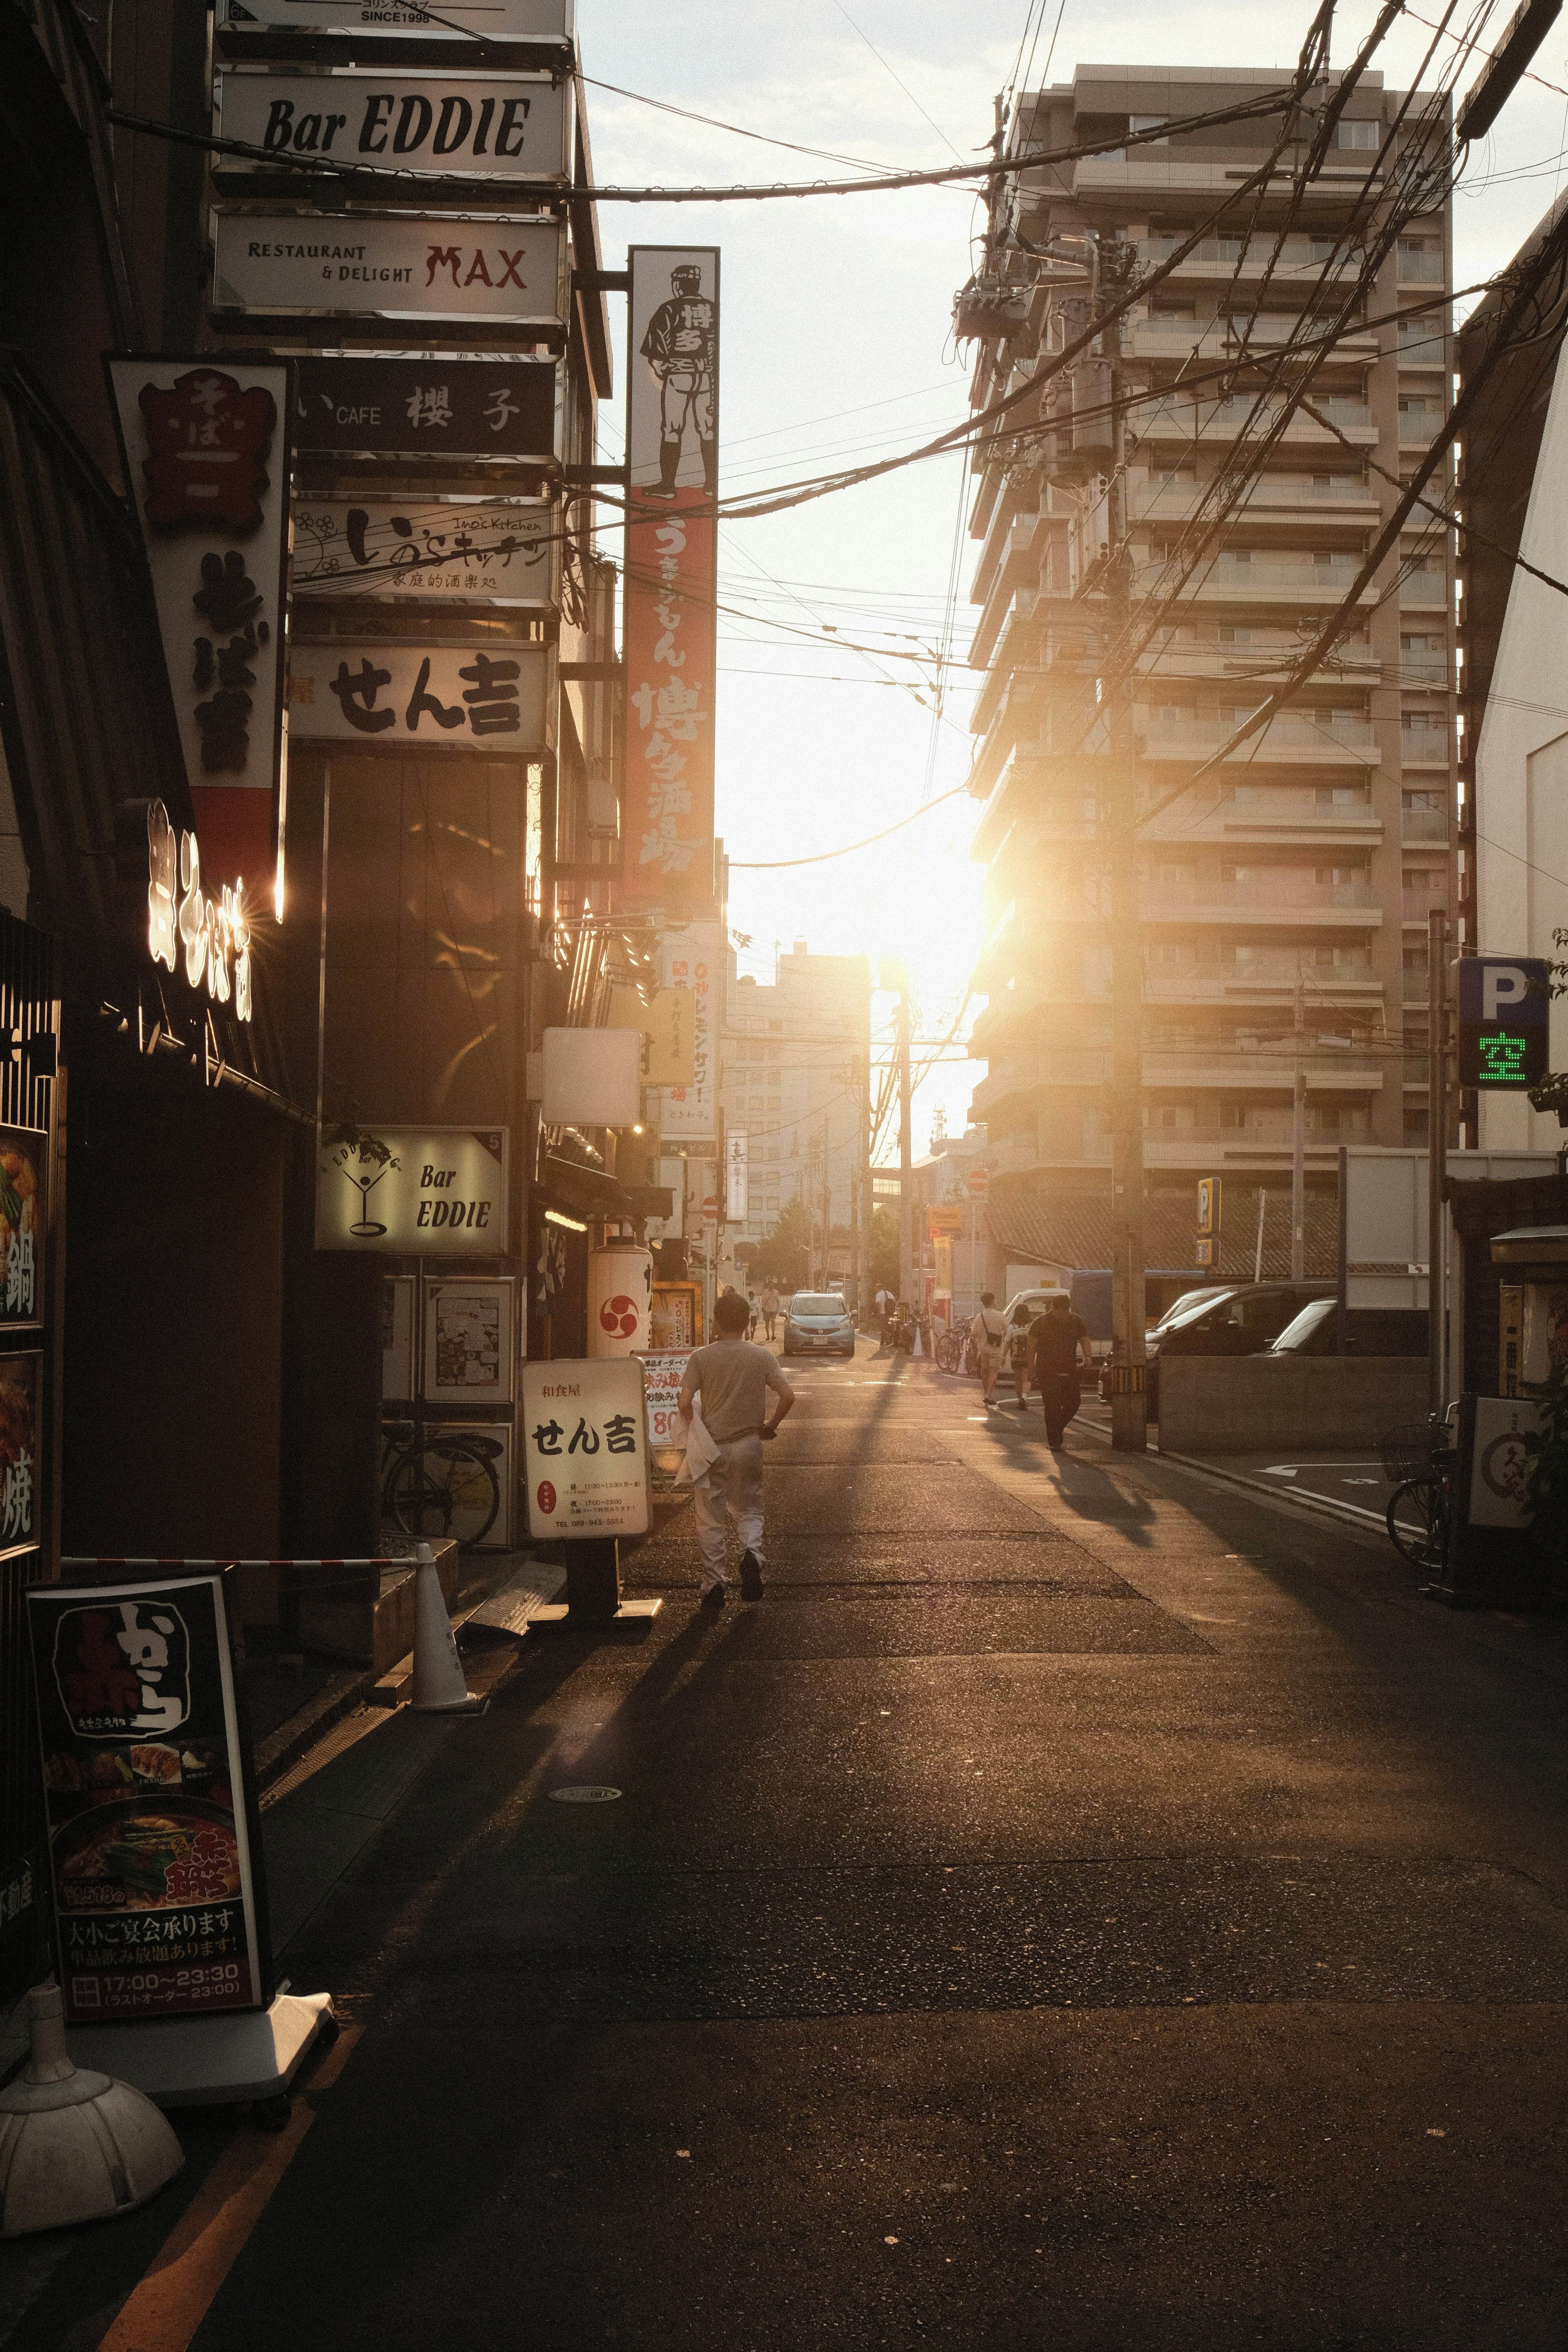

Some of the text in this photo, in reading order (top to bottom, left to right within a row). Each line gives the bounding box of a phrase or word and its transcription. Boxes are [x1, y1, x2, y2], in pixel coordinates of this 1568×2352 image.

[361, 11, 430, 23] SINCE1998
[263, 94, 531, 157] Bar EDDIE
[322, 266, 332, 279] &
[425, 245, 527, 289] MAX
[675, 304, 713, 352] 博多
[186, 377, 231, 447] そば
[336, 406, 381, 425] CAFE
[491, 518, 542, 531] Kitchen
[329, 652, 521, 736] せん吉
[1483, 966, 1527, 1019] P
[1479, 1031, 1526, 1080] 空
[489, 1134, 498, 1149] 5
[421, 1165, 457, 1188] Bar
[417, 1201, 491, 1228] EDDIE
[6, 1228, 35, 1314] 鍋
[542, 1384, 581, 1398] 和食屋
[532, 1414, 636, 1456] せん吉
[2, 1447, 33, 1538] 焼
[174, 1839, 191, 1861] 名物
[69, 1908, 234, 1946] 大小ご宴会承ります
